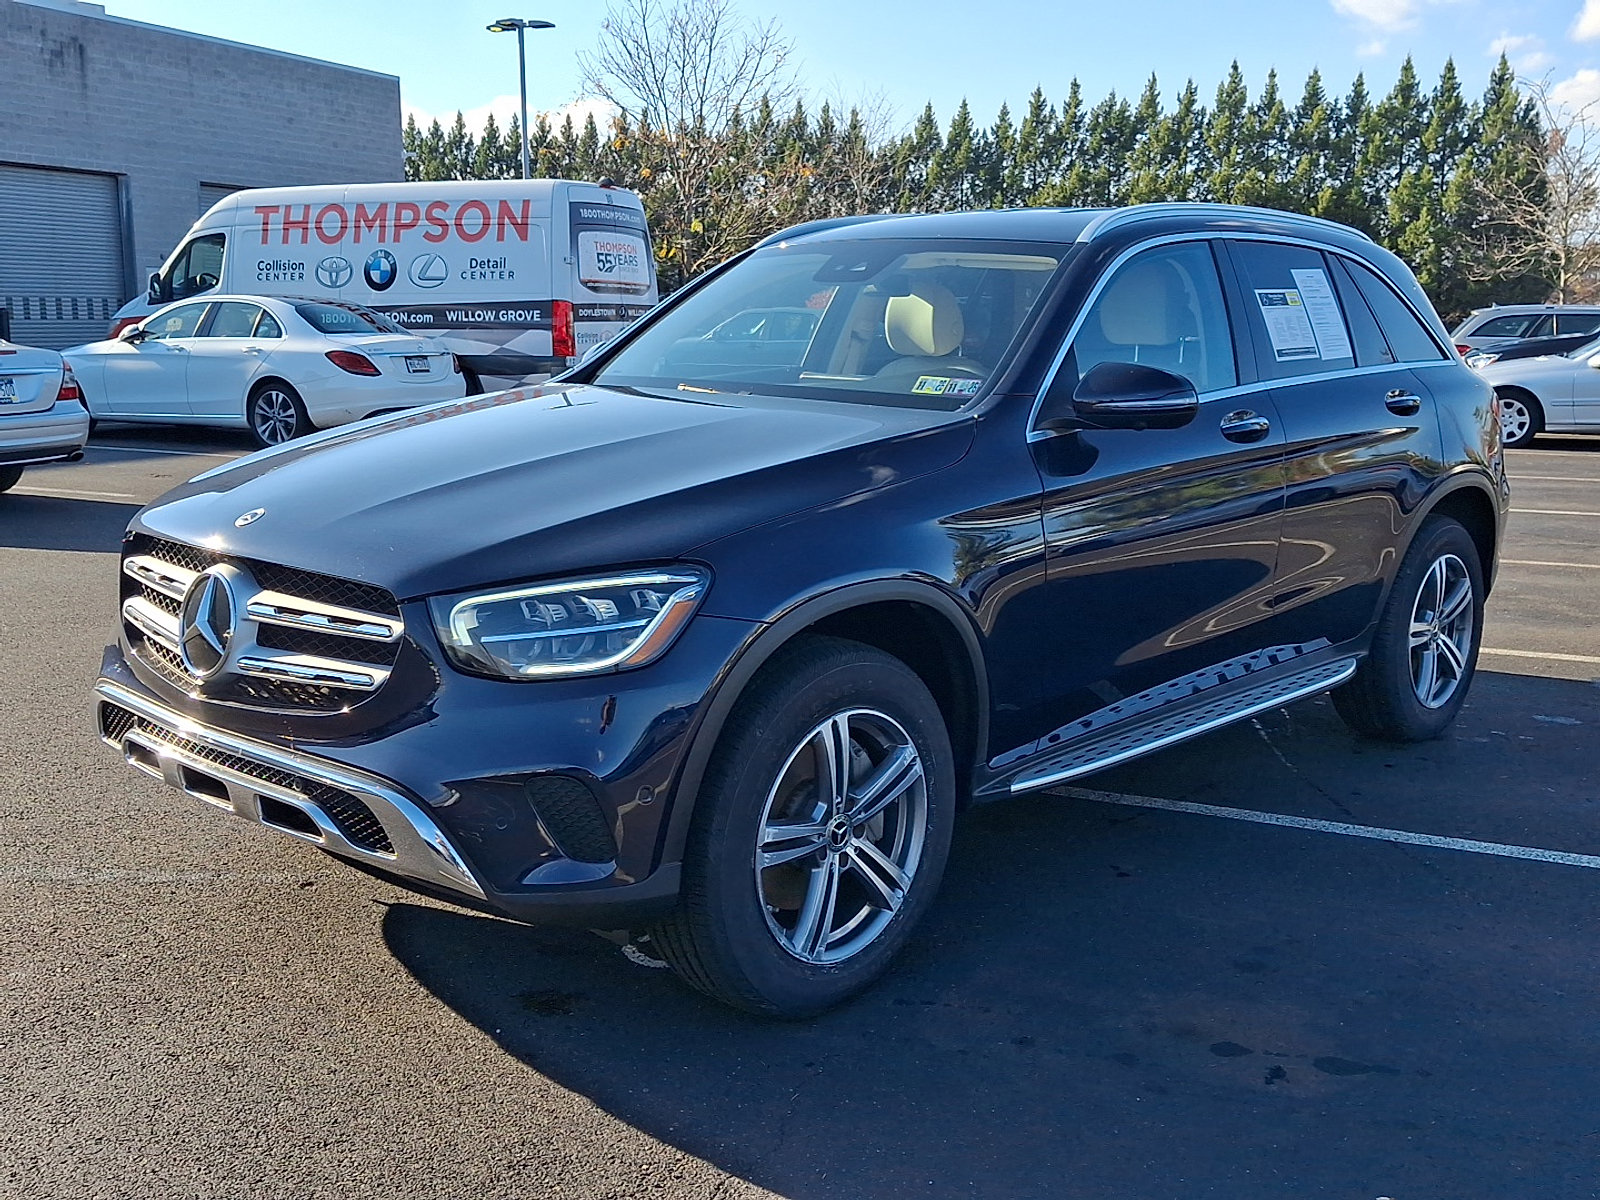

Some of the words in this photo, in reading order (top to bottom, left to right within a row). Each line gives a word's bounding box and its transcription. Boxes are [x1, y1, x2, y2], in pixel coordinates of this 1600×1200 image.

[254, 199, 531, 246] THOMPSON
[593, 241, 638, 255] THOMPSON
[257, 259, 305, 272] Collision
[468, 257, 507, 269] Detail
[613, 254, 639, 267] YEARS
[256, 272, 305, 282] CENTER
[460, 270, 515, 281] CENTER
[445, 310, 498, 322] WILLOW
[499, 309, 541, 322] GROVE
